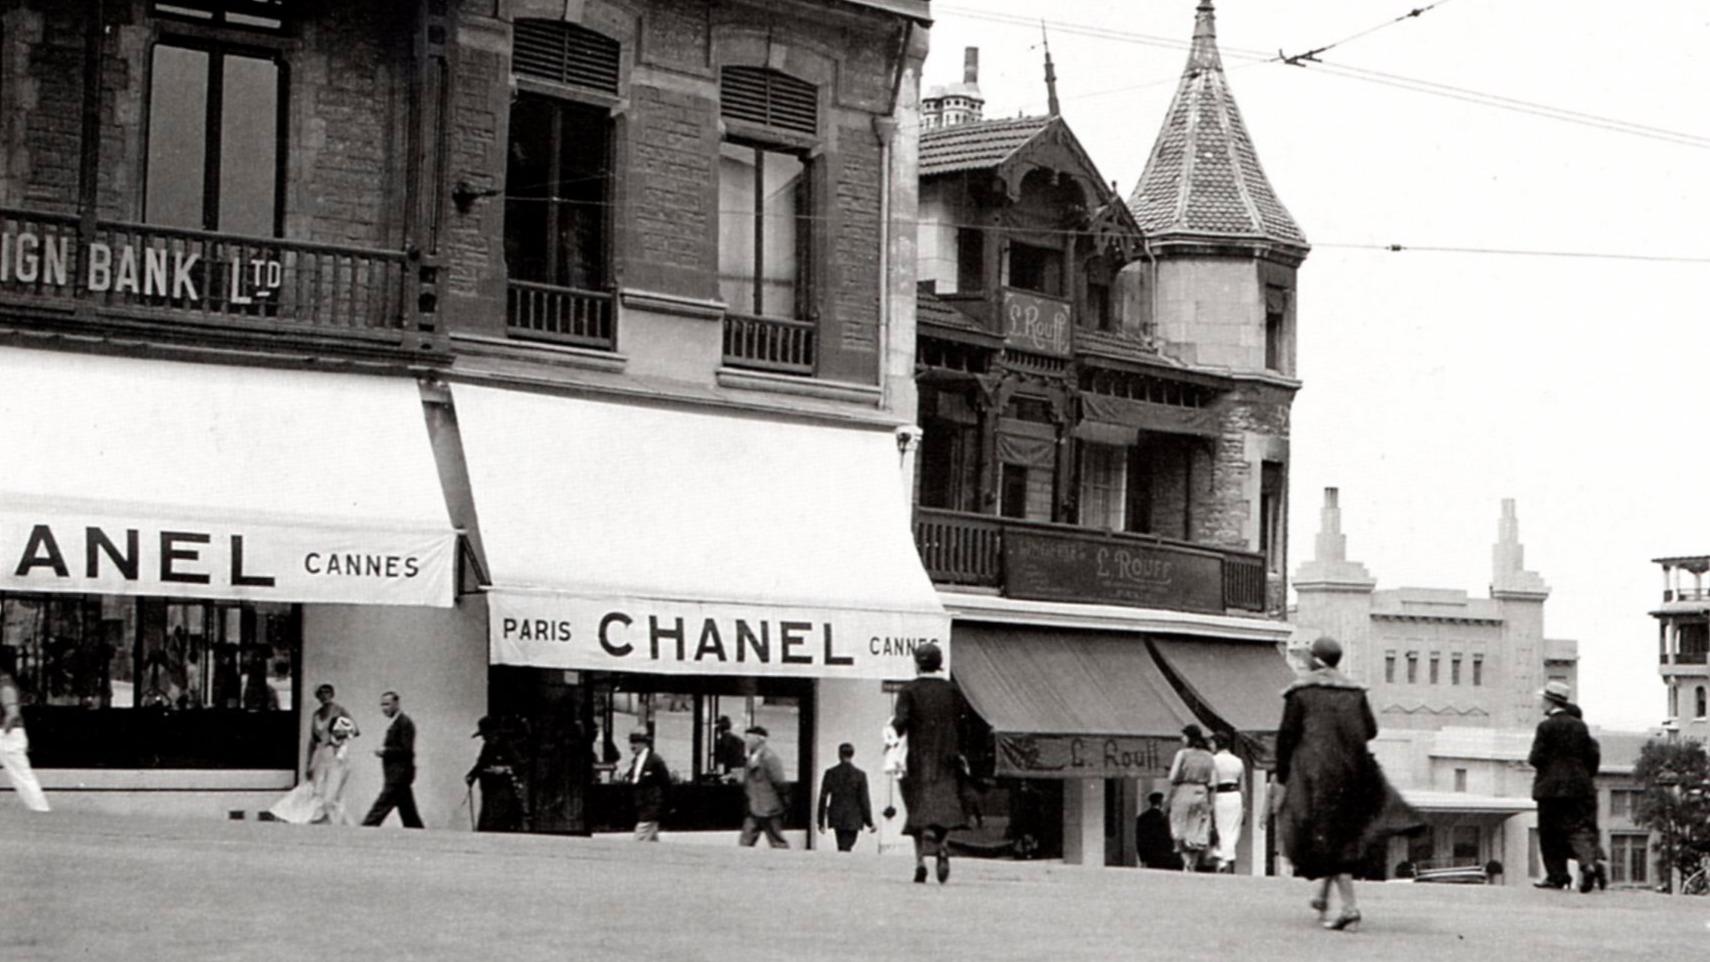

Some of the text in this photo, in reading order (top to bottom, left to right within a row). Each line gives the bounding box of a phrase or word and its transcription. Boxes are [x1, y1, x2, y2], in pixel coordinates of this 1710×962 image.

[1, 232, 68, 285] IGN
[88, 242, 199, 301] BANK
[15, 525, 420, 588] ANEL CANNES
[503, 612, 939, 666] PARIS CHANEL CANN
